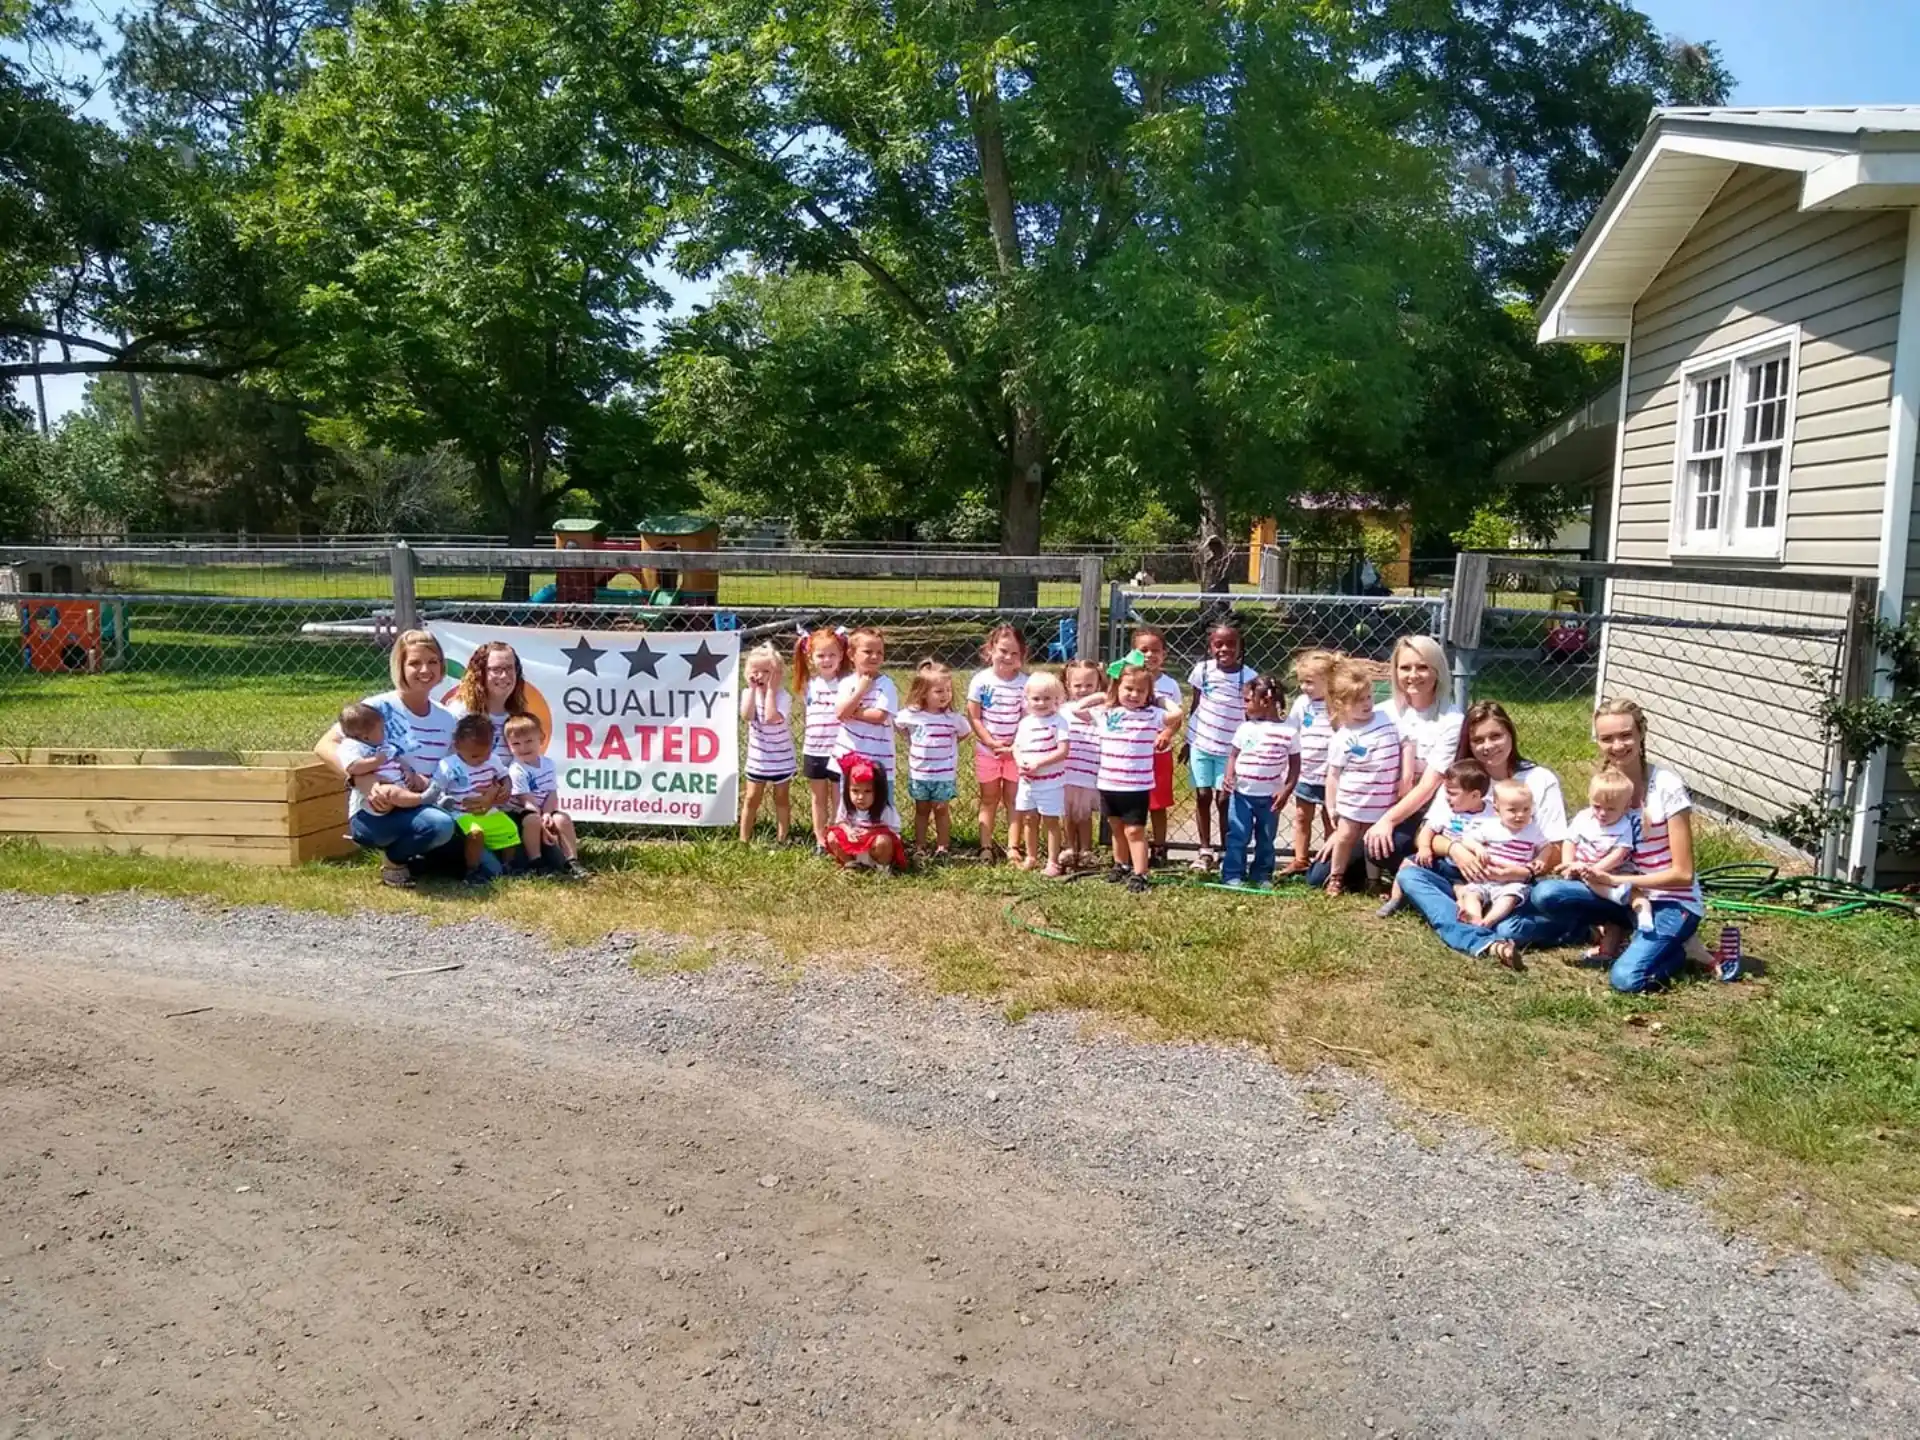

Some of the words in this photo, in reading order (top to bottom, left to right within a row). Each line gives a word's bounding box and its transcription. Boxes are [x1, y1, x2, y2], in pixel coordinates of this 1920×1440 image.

[563, 687, 718, 719] QUALITY
[566, 723, 720, 764] RATED
[565, 768, 642, 791] CHILD
[652, 771, 717, 794] CARE
[553, 795, 702, 818] ualityrated.org
